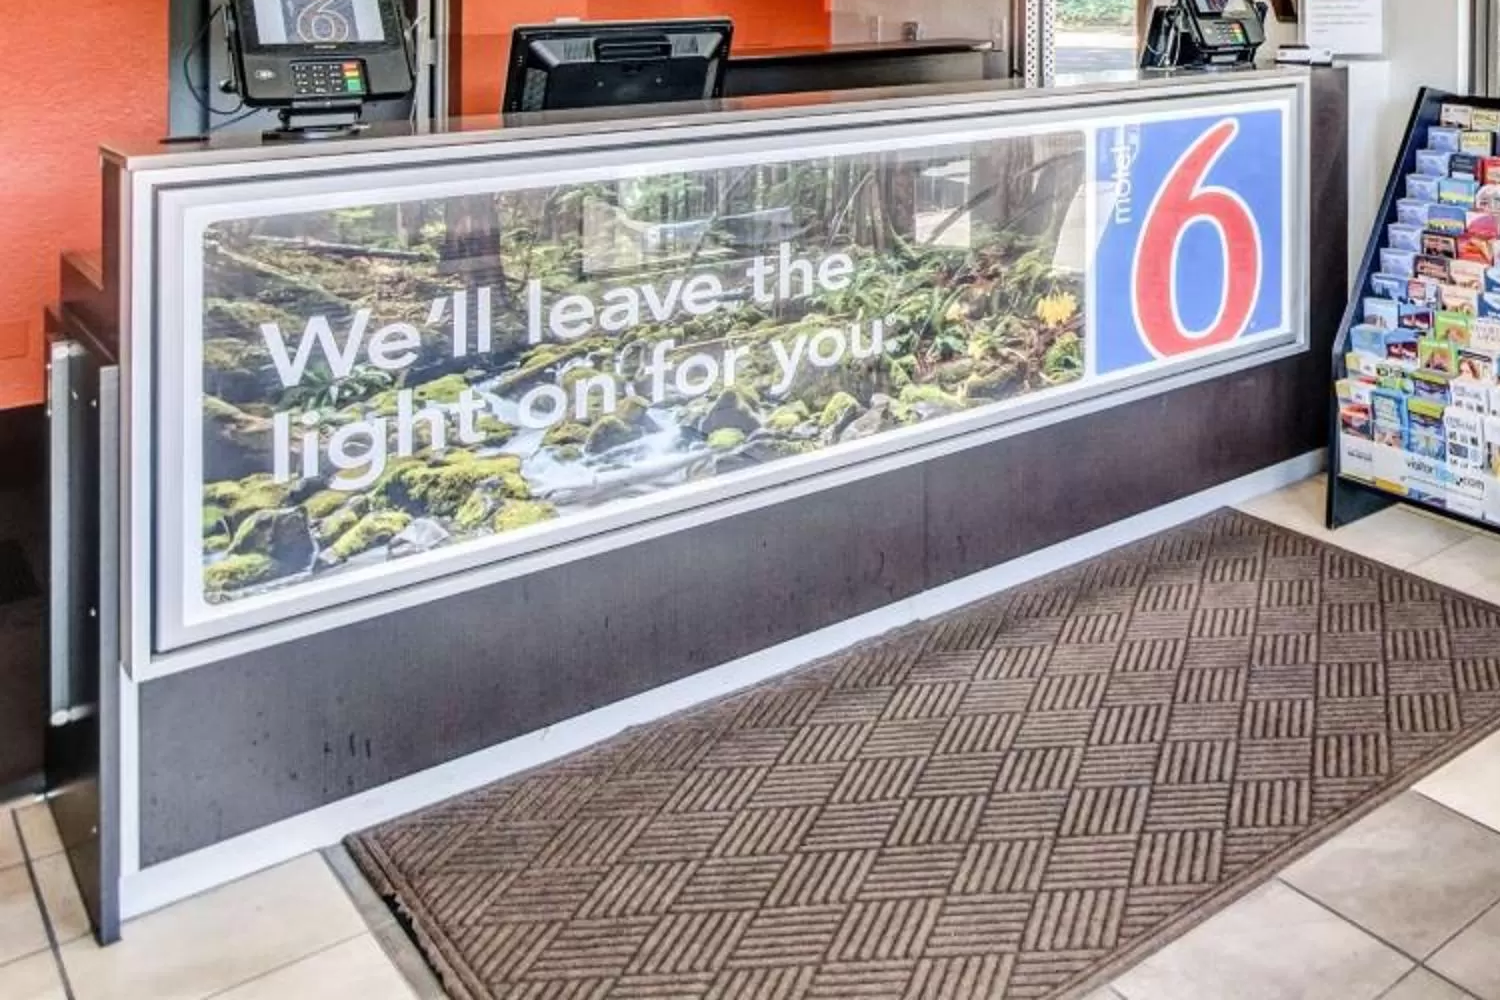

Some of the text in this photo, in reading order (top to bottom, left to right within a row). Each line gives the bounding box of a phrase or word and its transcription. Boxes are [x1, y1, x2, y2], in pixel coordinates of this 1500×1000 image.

[1110, 145, 1132, 224] motel
[1130, 116, 1264, 361] 6
[259, 242, 854, 387] We'll leave the
[272, 388, 487, 491] light
[517, 375, 618, 430] on
[646, 338, 750, 402] for
